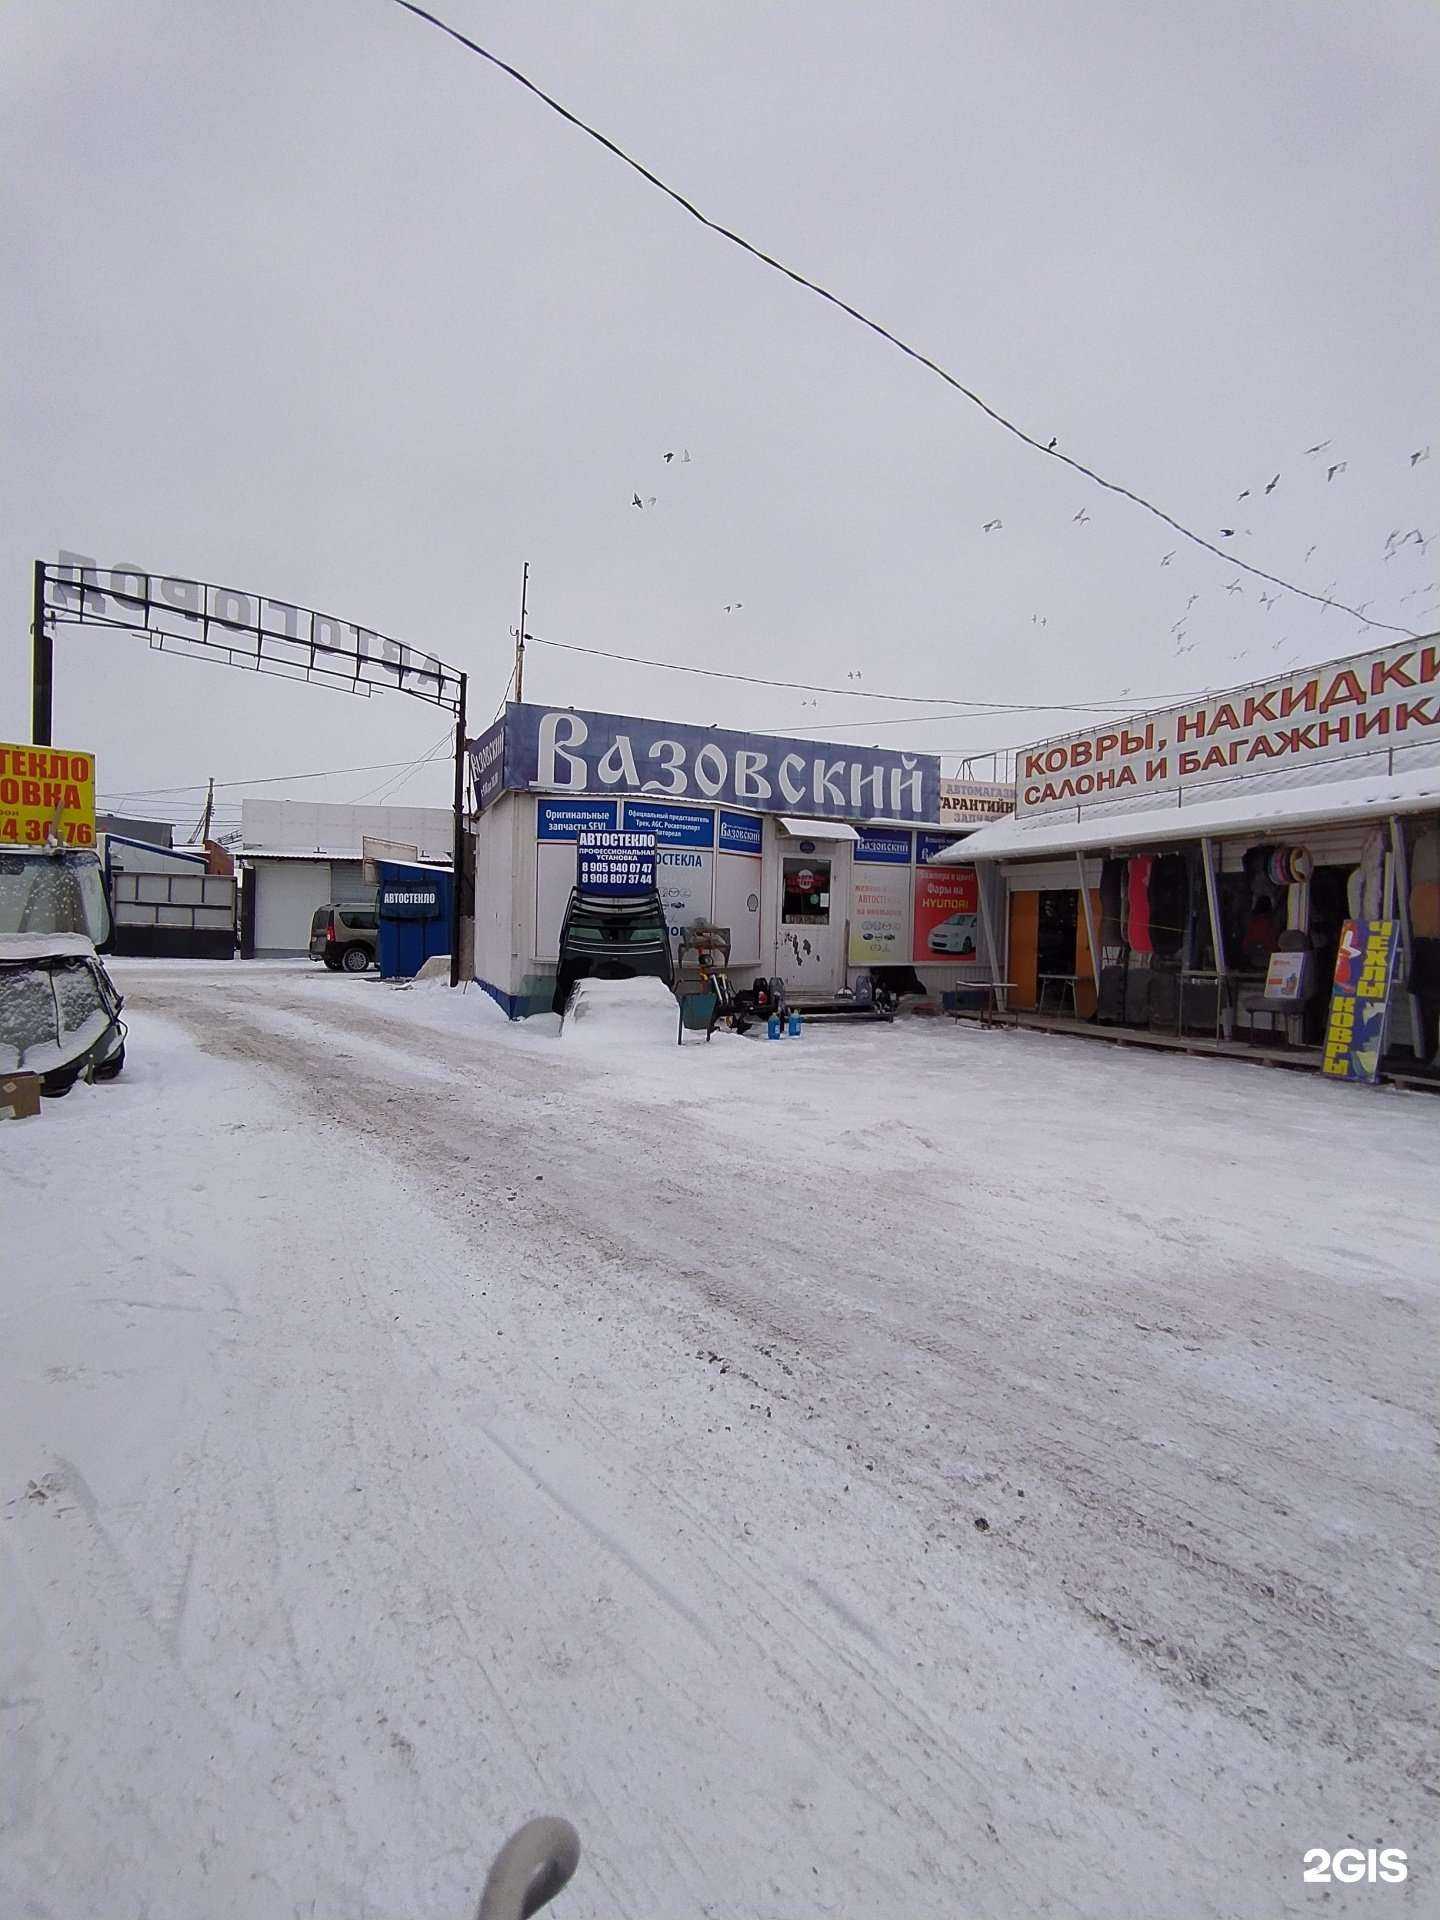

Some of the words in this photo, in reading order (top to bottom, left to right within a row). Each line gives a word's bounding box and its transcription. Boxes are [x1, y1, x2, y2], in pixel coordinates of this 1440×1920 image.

[1024, 764, 1137, 806] САЛОНА
[1145, 755, 1167, 782] И
[1178, 696, 1440, 775] БАГАЖНИК
[1025, 723, 1167, 778] КОВРЫ,
[0, 778, 81, 809] ОВКА
[940, 797, 1015, 814] АРАНТИЙН
[545, 809, 610, 821] Оригинальные
[64, 822, 92, 843] 76
[548, 823, 587, 831] запчасти
[579, 832, 655, 847] АВТОСТЕКЛО
[582, 862, 588, 872] 8
[590, 862, 608, 872] 905
[610, 863, 627, 873] 940
[630, 863, 640, 873] 07
[641, 863, 652, 873] 47
[582, 873, 588, 883] 8
[590, 874, 608, 883] 908
[610, 874, 626, 883] 807
[628, 874, 640, 883] 37
[640, 874, 652, 884] 44
[384, 893, 435, 904] АВТОСТЕКЛО
[1356, 920, 1393, 998] ЧЕХЛЫ
[1322, 996, 1356, 1076] КОВРЫ
